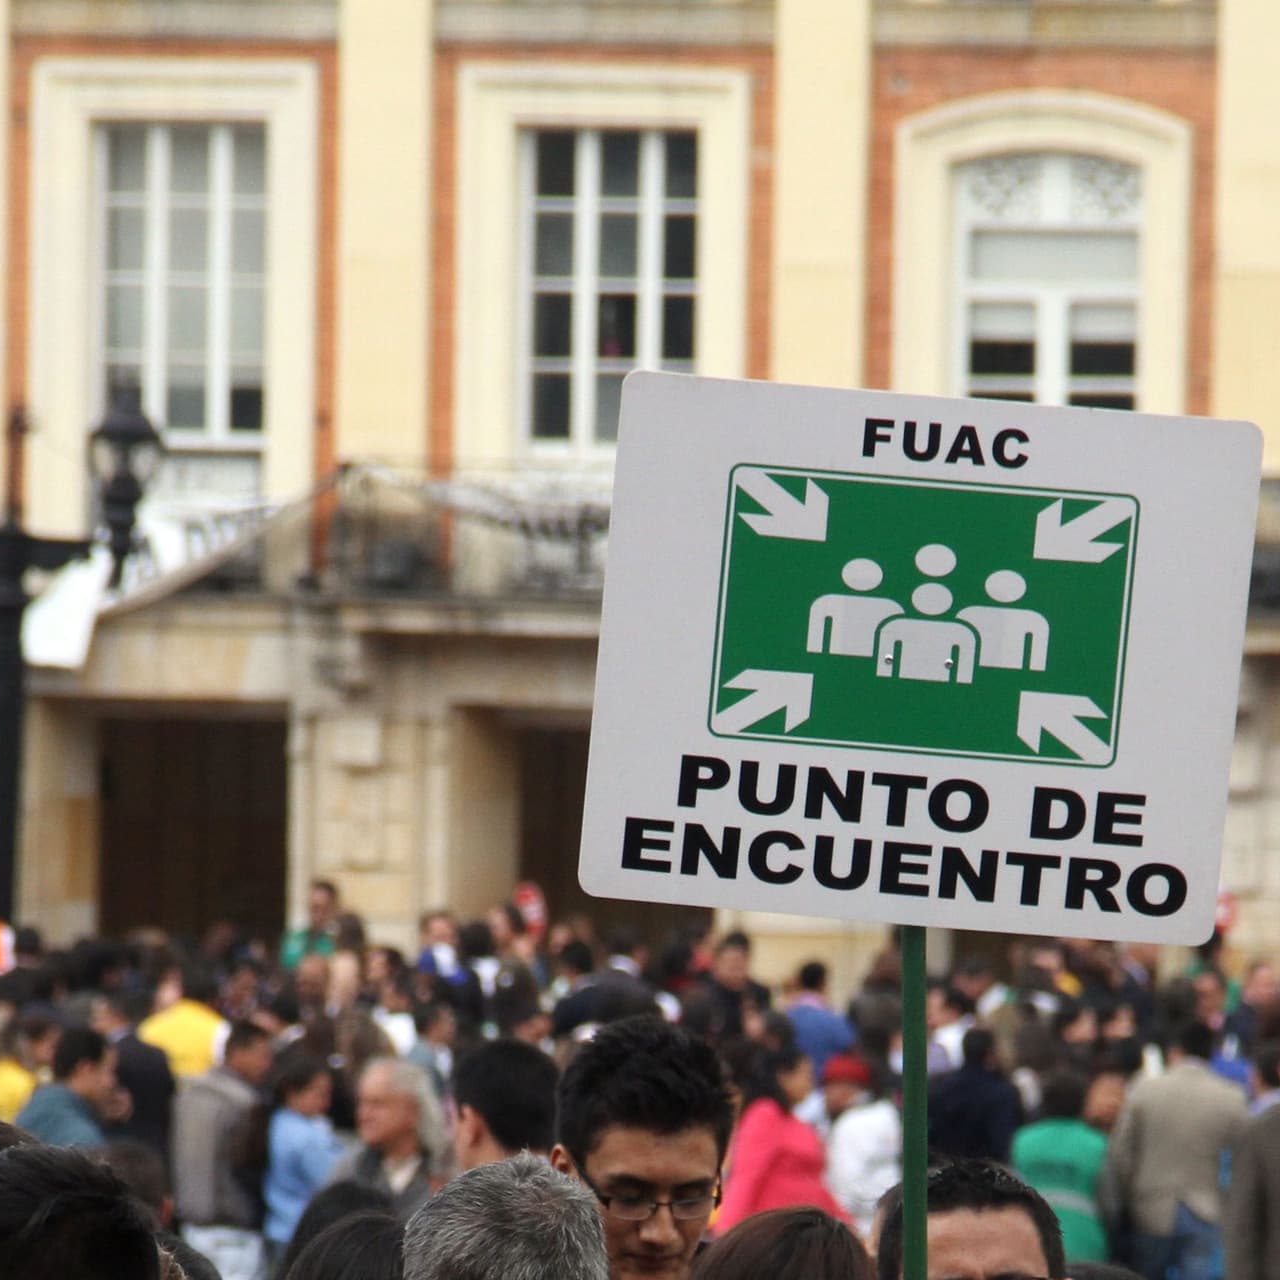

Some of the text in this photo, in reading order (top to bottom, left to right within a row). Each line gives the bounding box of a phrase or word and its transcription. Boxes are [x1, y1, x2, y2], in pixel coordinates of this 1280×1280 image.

[862, 418, 1030, 469] FUAC
[677, 754, 1147, 847] PUNTO DE
[620, 816, 1189, 917] ENCUENTRO
